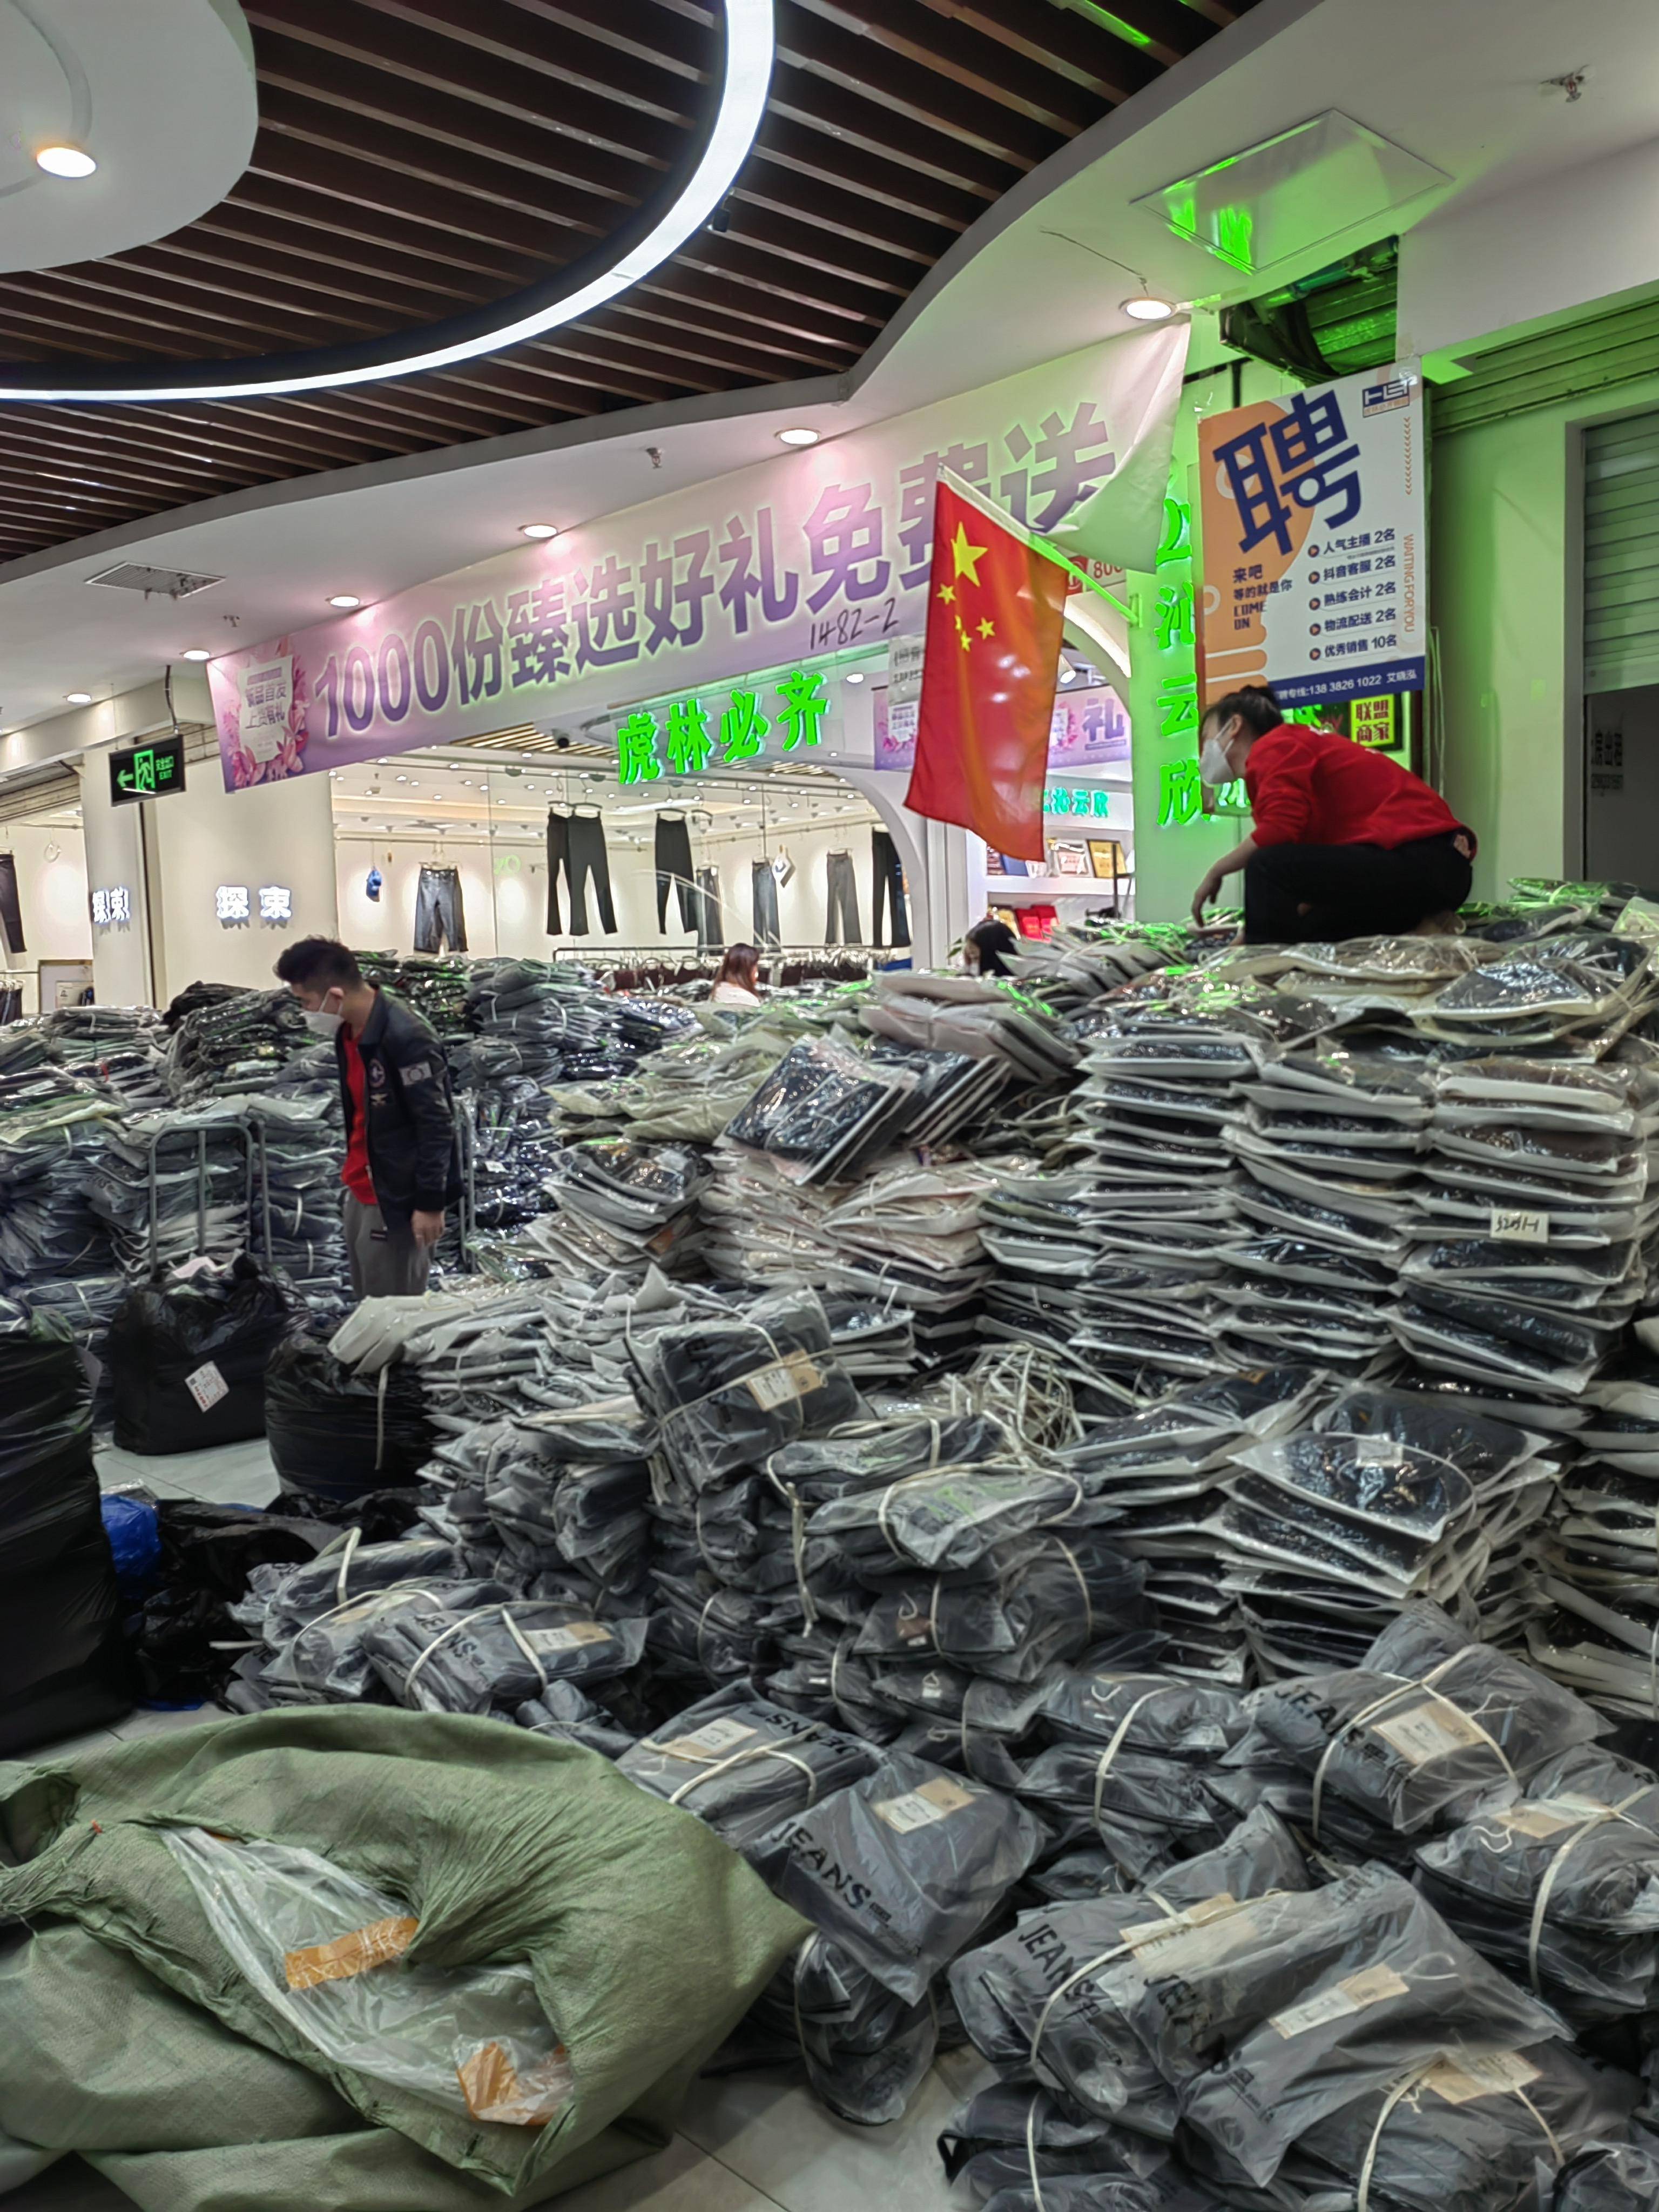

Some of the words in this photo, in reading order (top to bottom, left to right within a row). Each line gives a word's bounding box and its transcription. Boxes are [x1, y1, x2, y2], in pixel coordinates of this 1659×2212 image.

[1212, 389, 1361, 556] 聘
[1324, 533, 1371, 554] 人气主播
[1374, 528, 1395, 543] 2名
[1324, 559, 1371, 581] 抖音客服
[1375, 555, 1395, 570] 2名
[1404, 534, 1414, 583] WAITING
[1233, 564, 1263, 583] 来吧
[1234, 579, 1292, 601] 等的就是你
[1324, 586, 1372, 606] 熟练会计
[1375, 582, 1396, 596] 2名
[1404, 584, 1414, 607] FOR
[1235, 601, 1267, 617] COME
[1324, 612, 1372, 632] 物流配送
[1375, 608, 1396, 622] 2名
[1405, 608, 1415, 632] YOU
[811, 597, 899, 650] 1482-2
[1235, 617, 1250, 630] ON
[1325, 639, 1368, 658] 优秀销售
[1372, 634, 1397, 649] 10名
[1329, 679, 1354, 692] 3826
[1357, 675, 1381, 687] 1022
[1355, 699, 1389, 721] 联盟
[617, 671, 828, 784] 虎林必齐
[771, 1822, 872, 1910] JEANS
